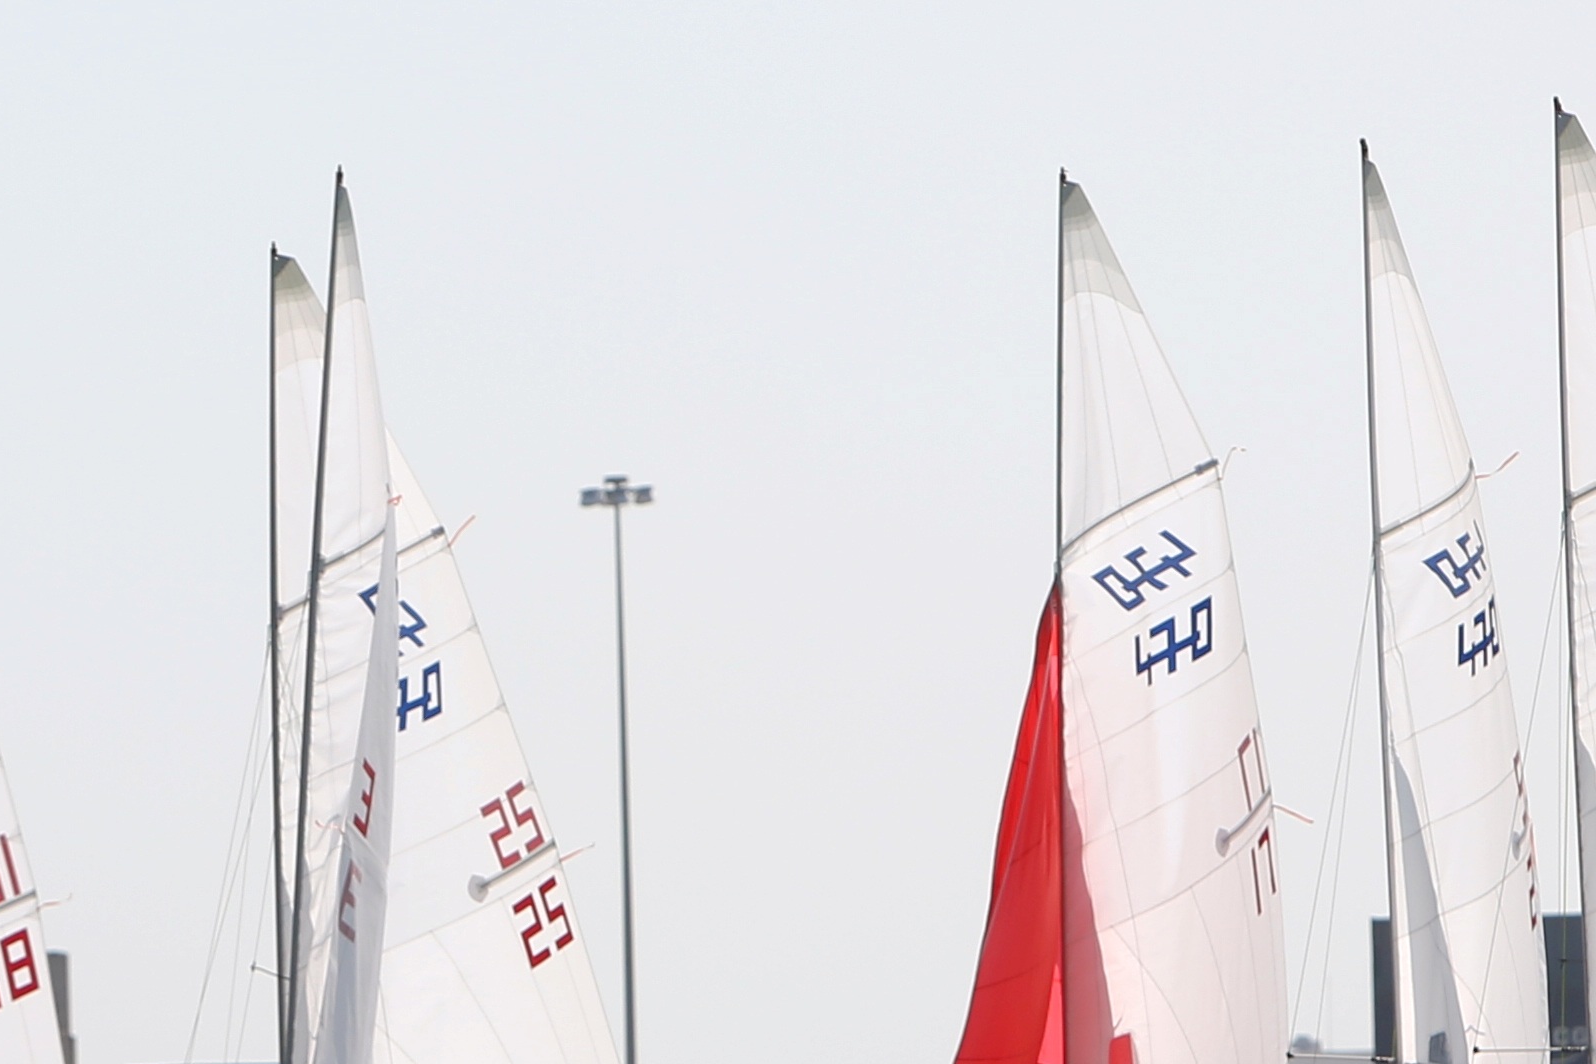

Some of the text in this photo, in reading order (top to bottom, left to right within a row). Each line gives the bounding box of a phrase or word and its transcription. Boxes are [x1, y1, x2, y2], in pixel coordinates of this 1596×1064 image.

[1135, 595, 1212, 687] 470
[480, 780, 545, 870] 25
[512, 875, 574, 969] 25
